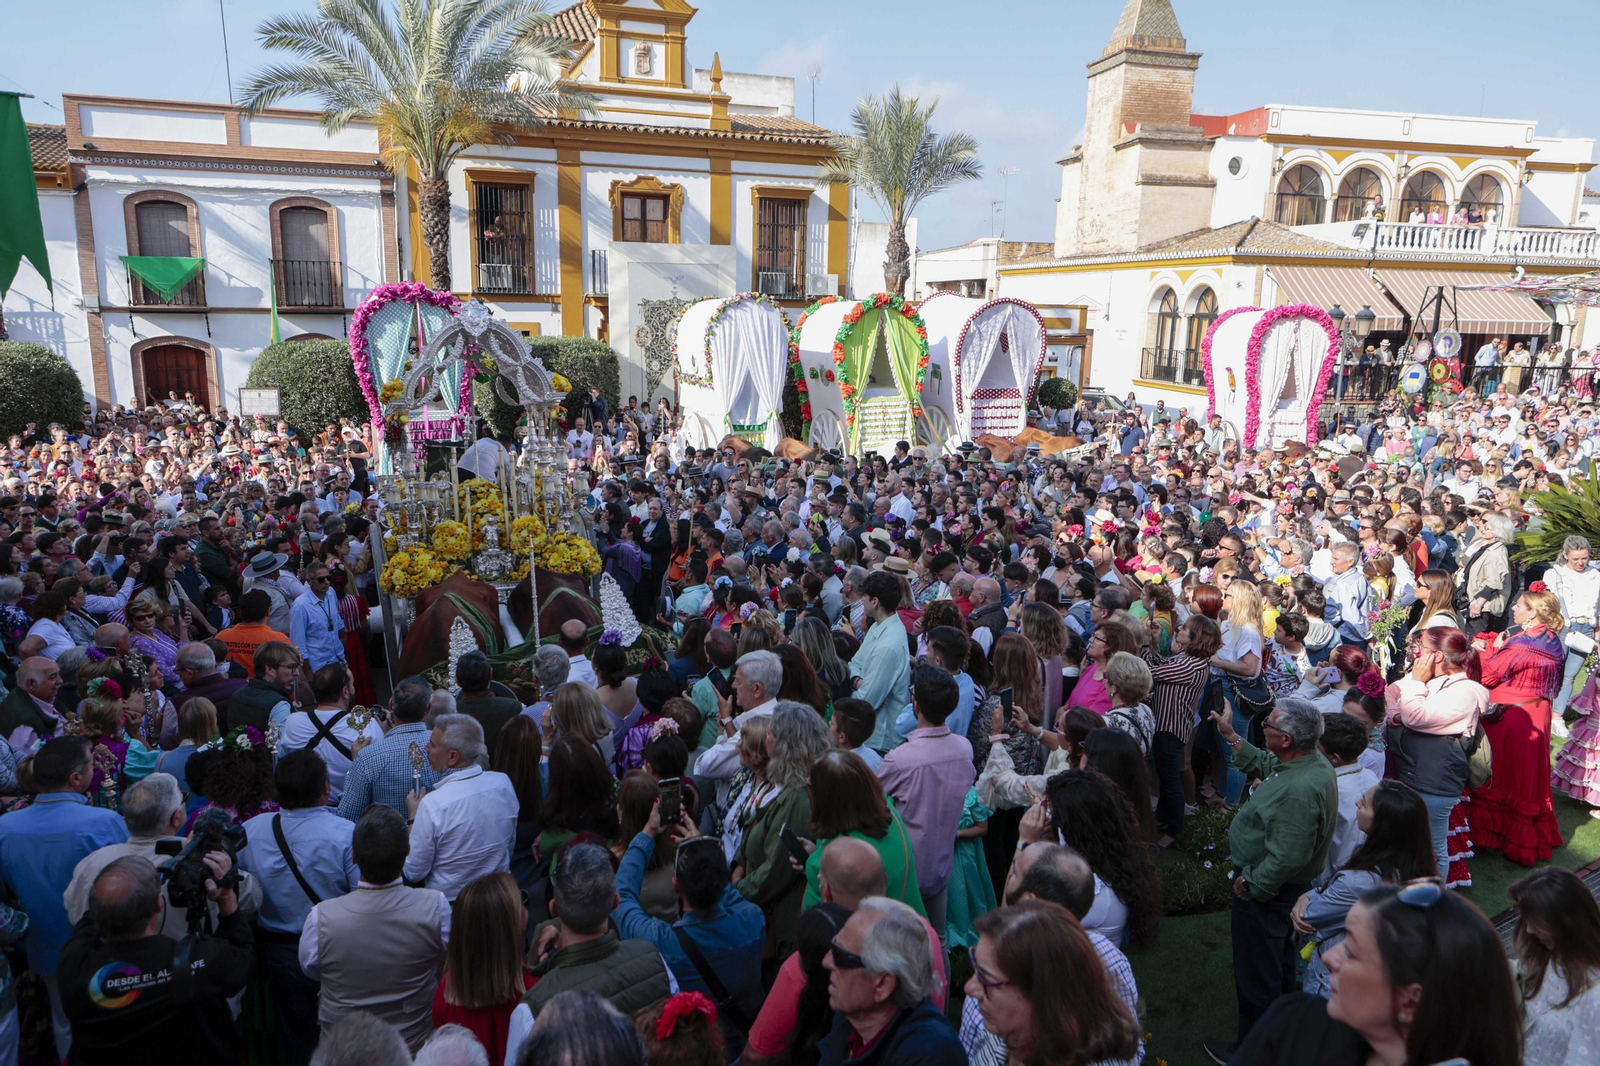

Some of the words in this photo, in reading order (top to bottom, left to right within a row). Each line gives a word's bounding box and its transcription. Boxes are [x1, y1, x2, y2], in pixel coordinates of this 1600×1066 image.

[107, 975, 140, 988] DESDE
[143, 973, 155, 982] EL
[132, 980, 157, 990] noticias
